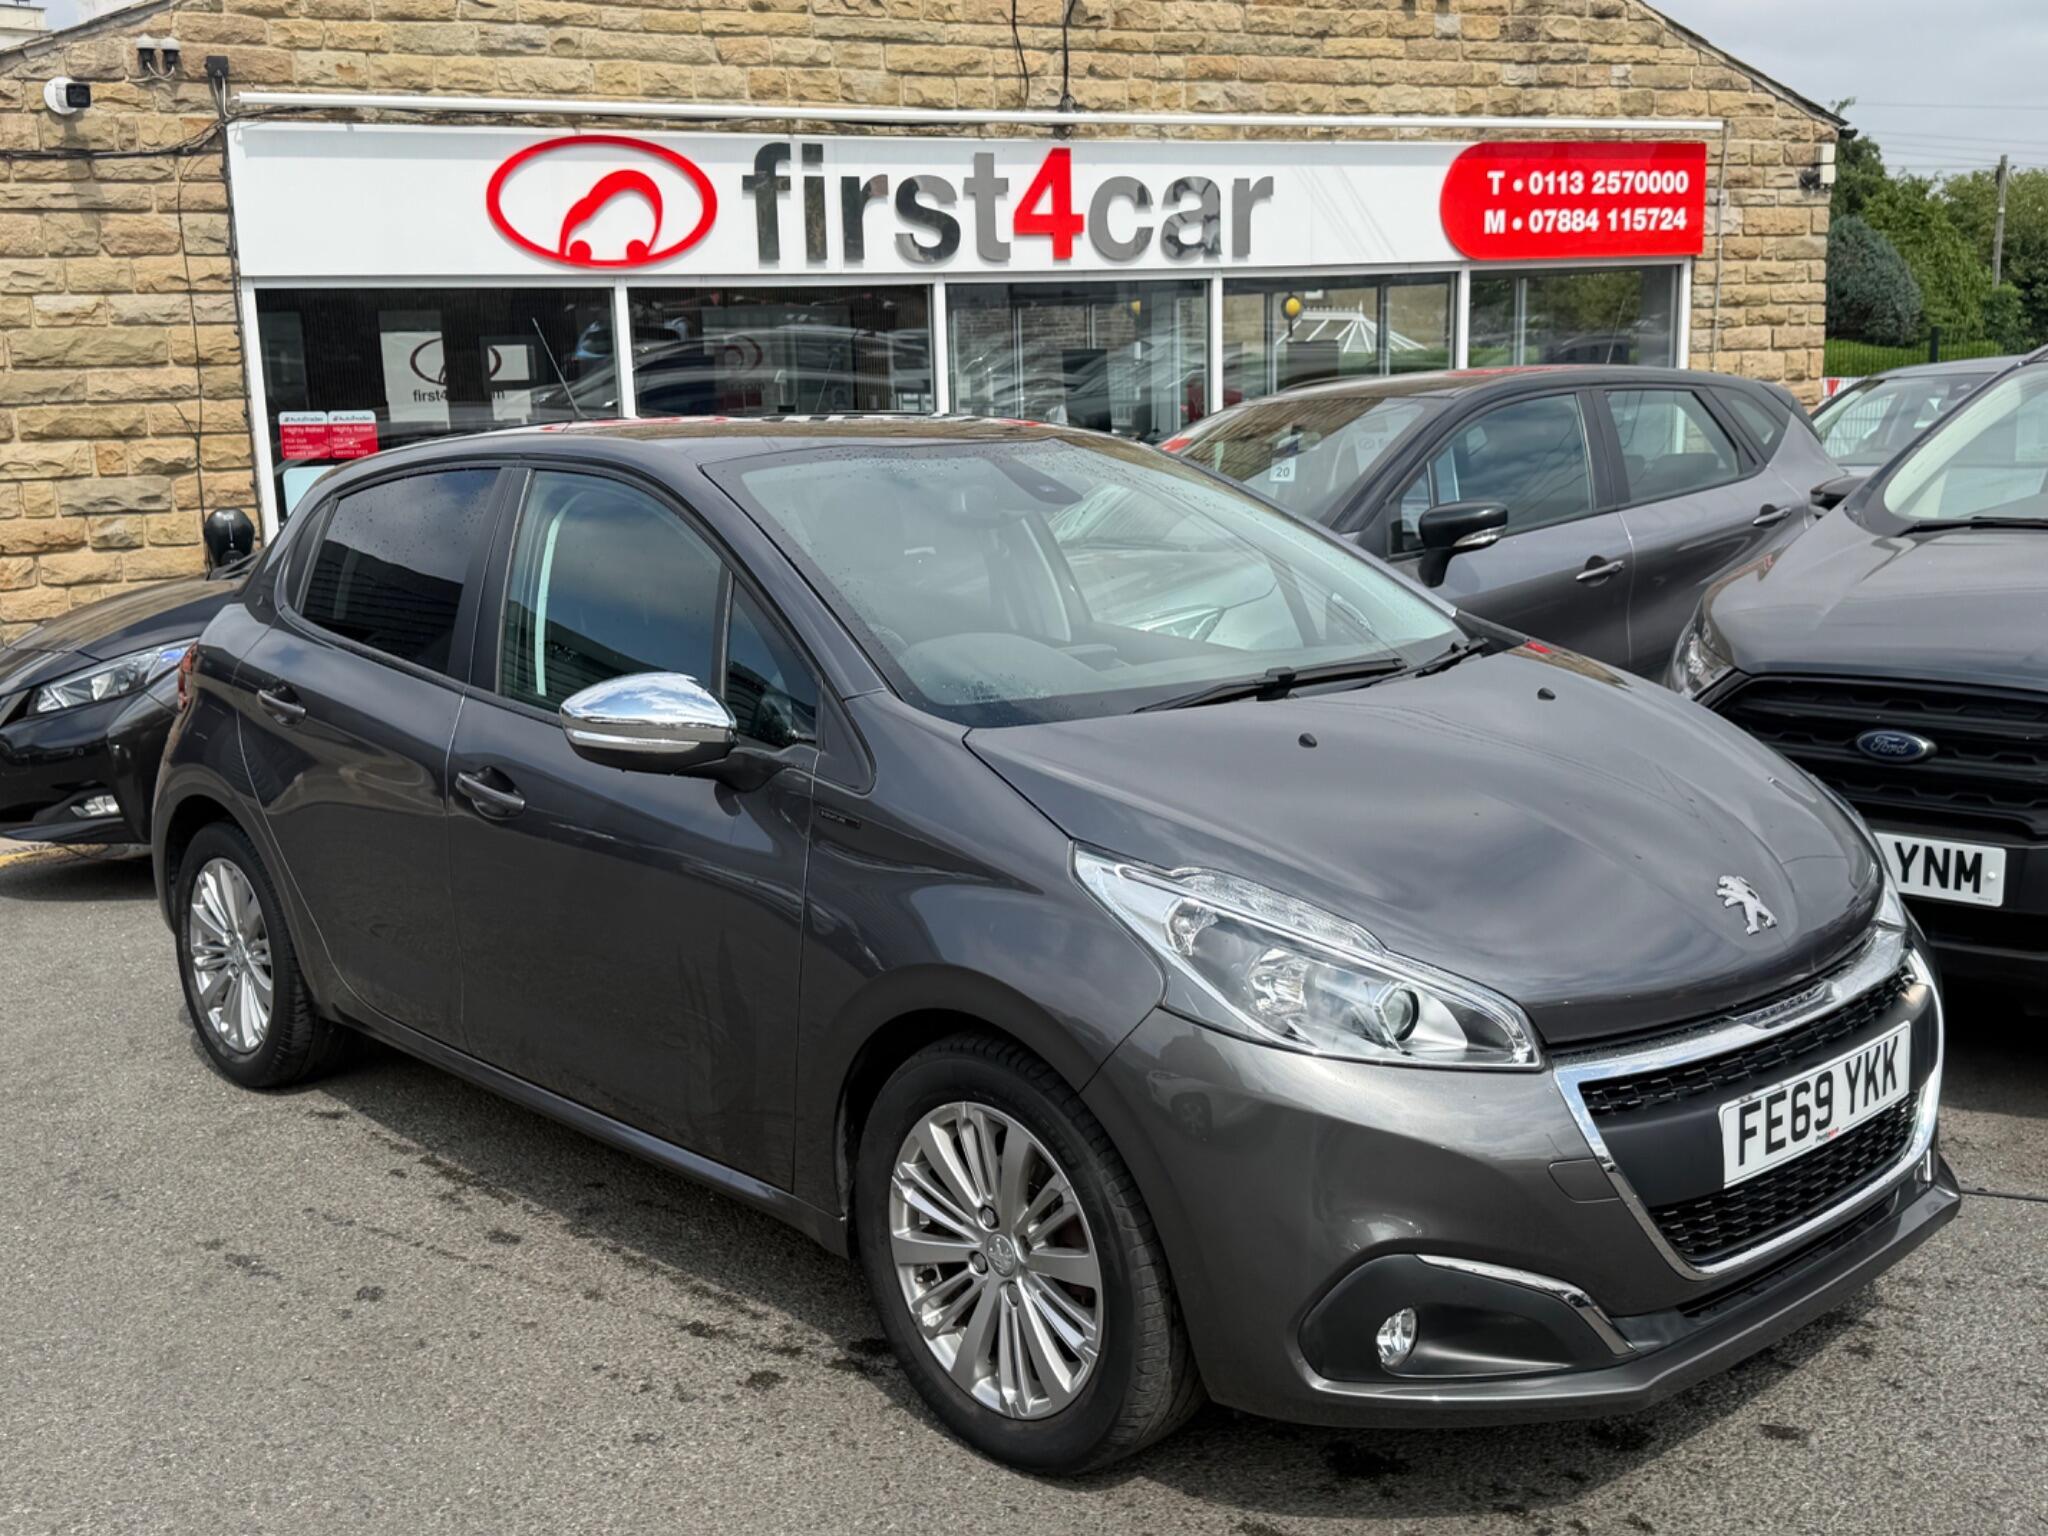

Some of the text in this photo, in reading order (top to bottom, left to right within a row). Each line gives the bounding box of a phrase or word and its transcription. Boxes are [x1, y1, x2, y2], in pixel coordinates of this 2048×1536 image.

[1591, 170, 1689, 194] 2570000
[742, 142, 1273, 263] first4car
[1607, 207, 1687, 232] 115724
[1276, 466, 1290, 478] 20
[1870, 735, 1911, 755] Ford
[1894, 841, 1983, 894] YNM
[1738, 1034, 1899, 1168] FE69 YKK
